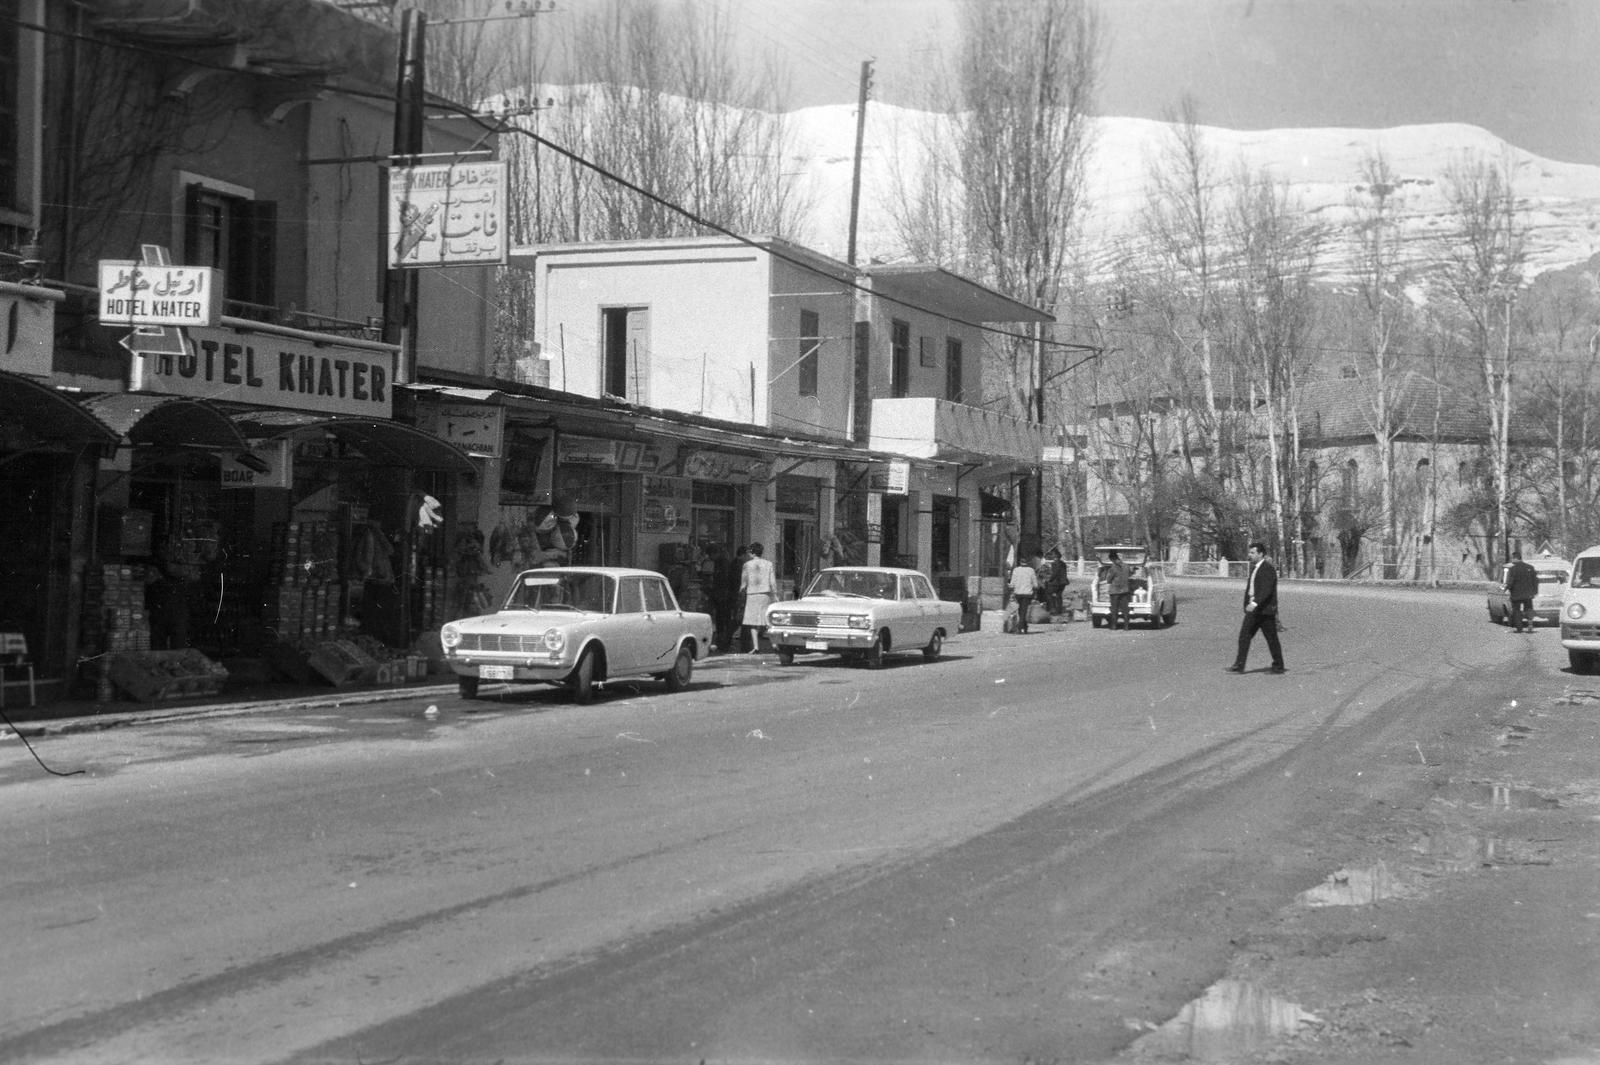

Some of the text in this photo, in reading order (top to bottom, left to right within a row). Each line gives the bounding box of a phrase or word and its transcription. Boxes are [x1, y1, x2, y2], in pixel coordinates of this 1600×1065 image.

[409, 171, 451, 189] KHATER
[440, 210, 498, 238] فانتا
[106, 269, 151, 294] خاطر
[107, 298, 201, 318] HOTEL KHATER
[279, 351, 386, 403] KHATER
